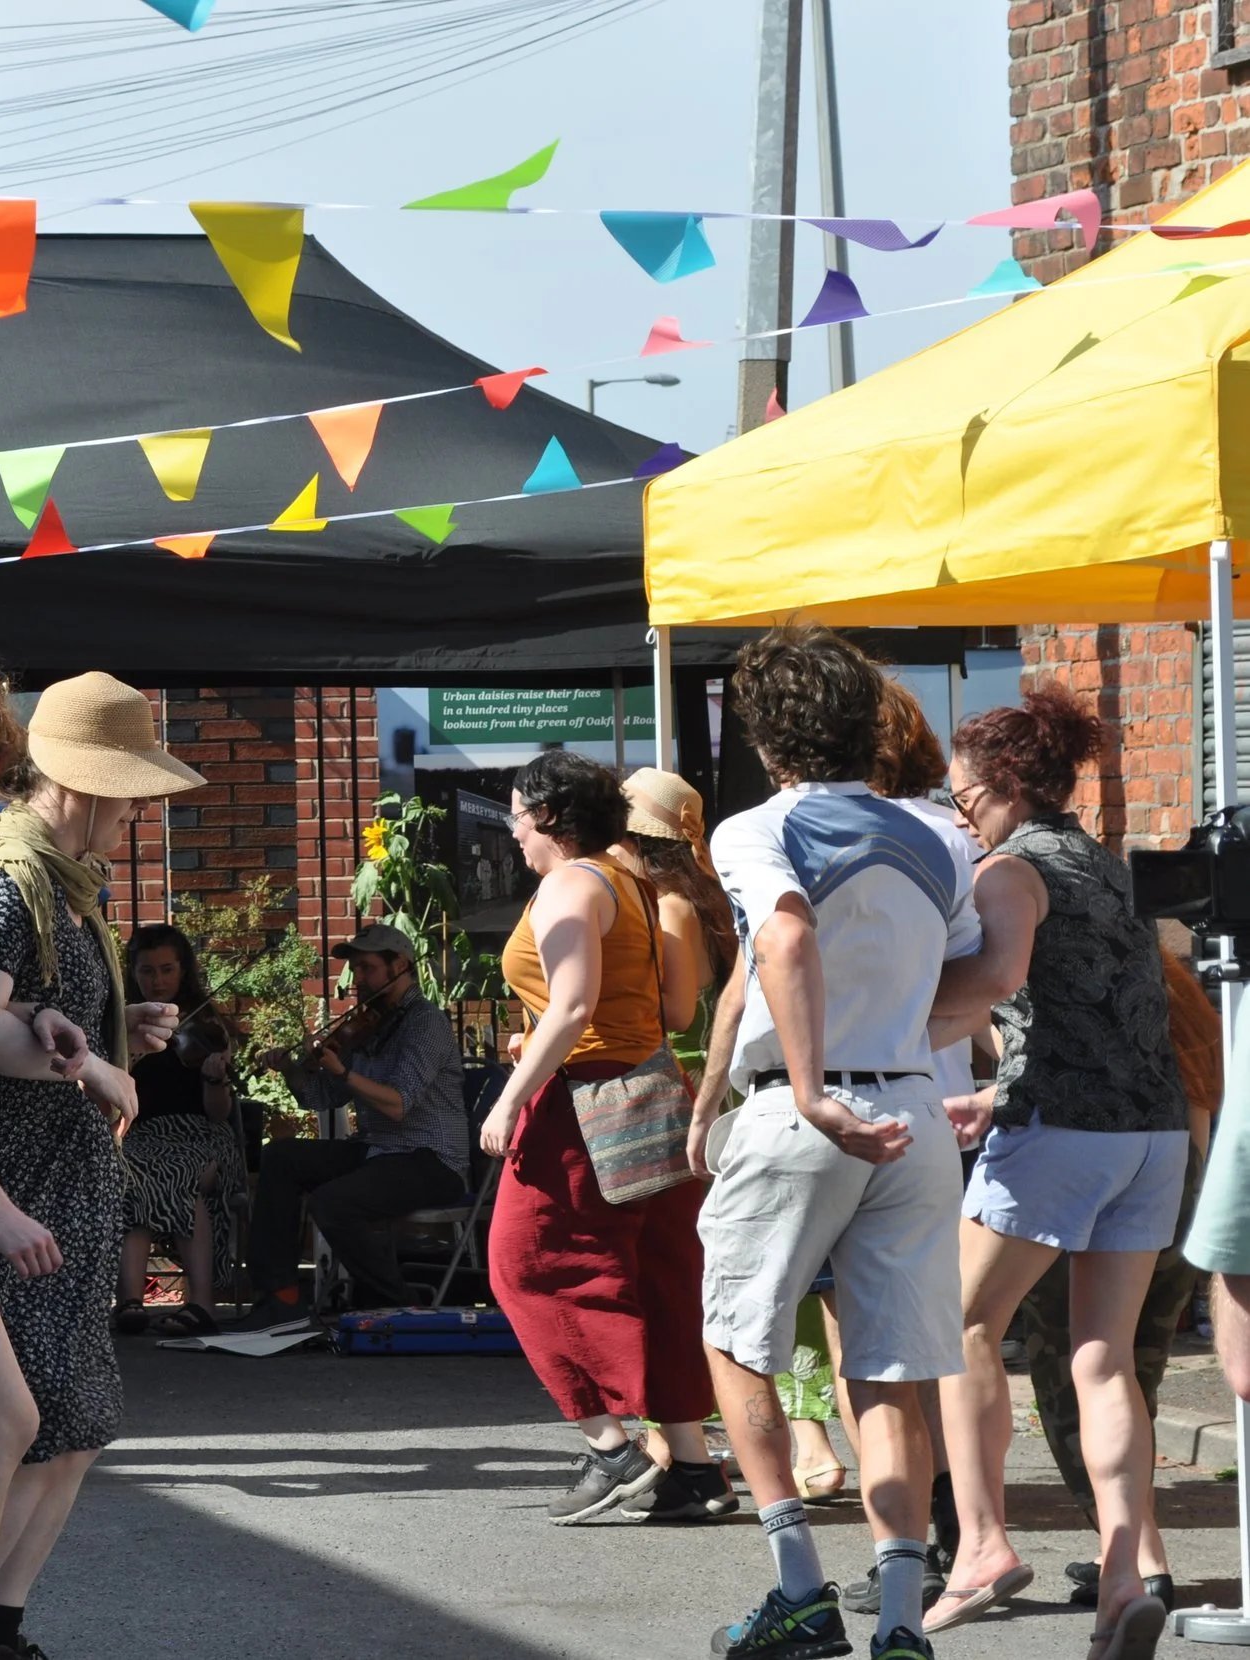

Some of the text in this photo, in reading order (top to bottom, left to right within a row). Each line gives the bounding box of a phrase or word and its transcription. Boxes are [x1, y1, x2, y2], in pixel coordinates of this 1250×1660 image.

[443, 689, 601, 701] Urban daisies raise their faces
[443, 704, 568, 716] in a hundred tiny places
[443, 720, 488, 730] lookouts
[489, 719, 516, 731] from
[519, 718, 536, 728] the
[537, 718, 567, 730] green
[569, 717, 585, 728] off
[586, 716, 631, 727] Oakfid
